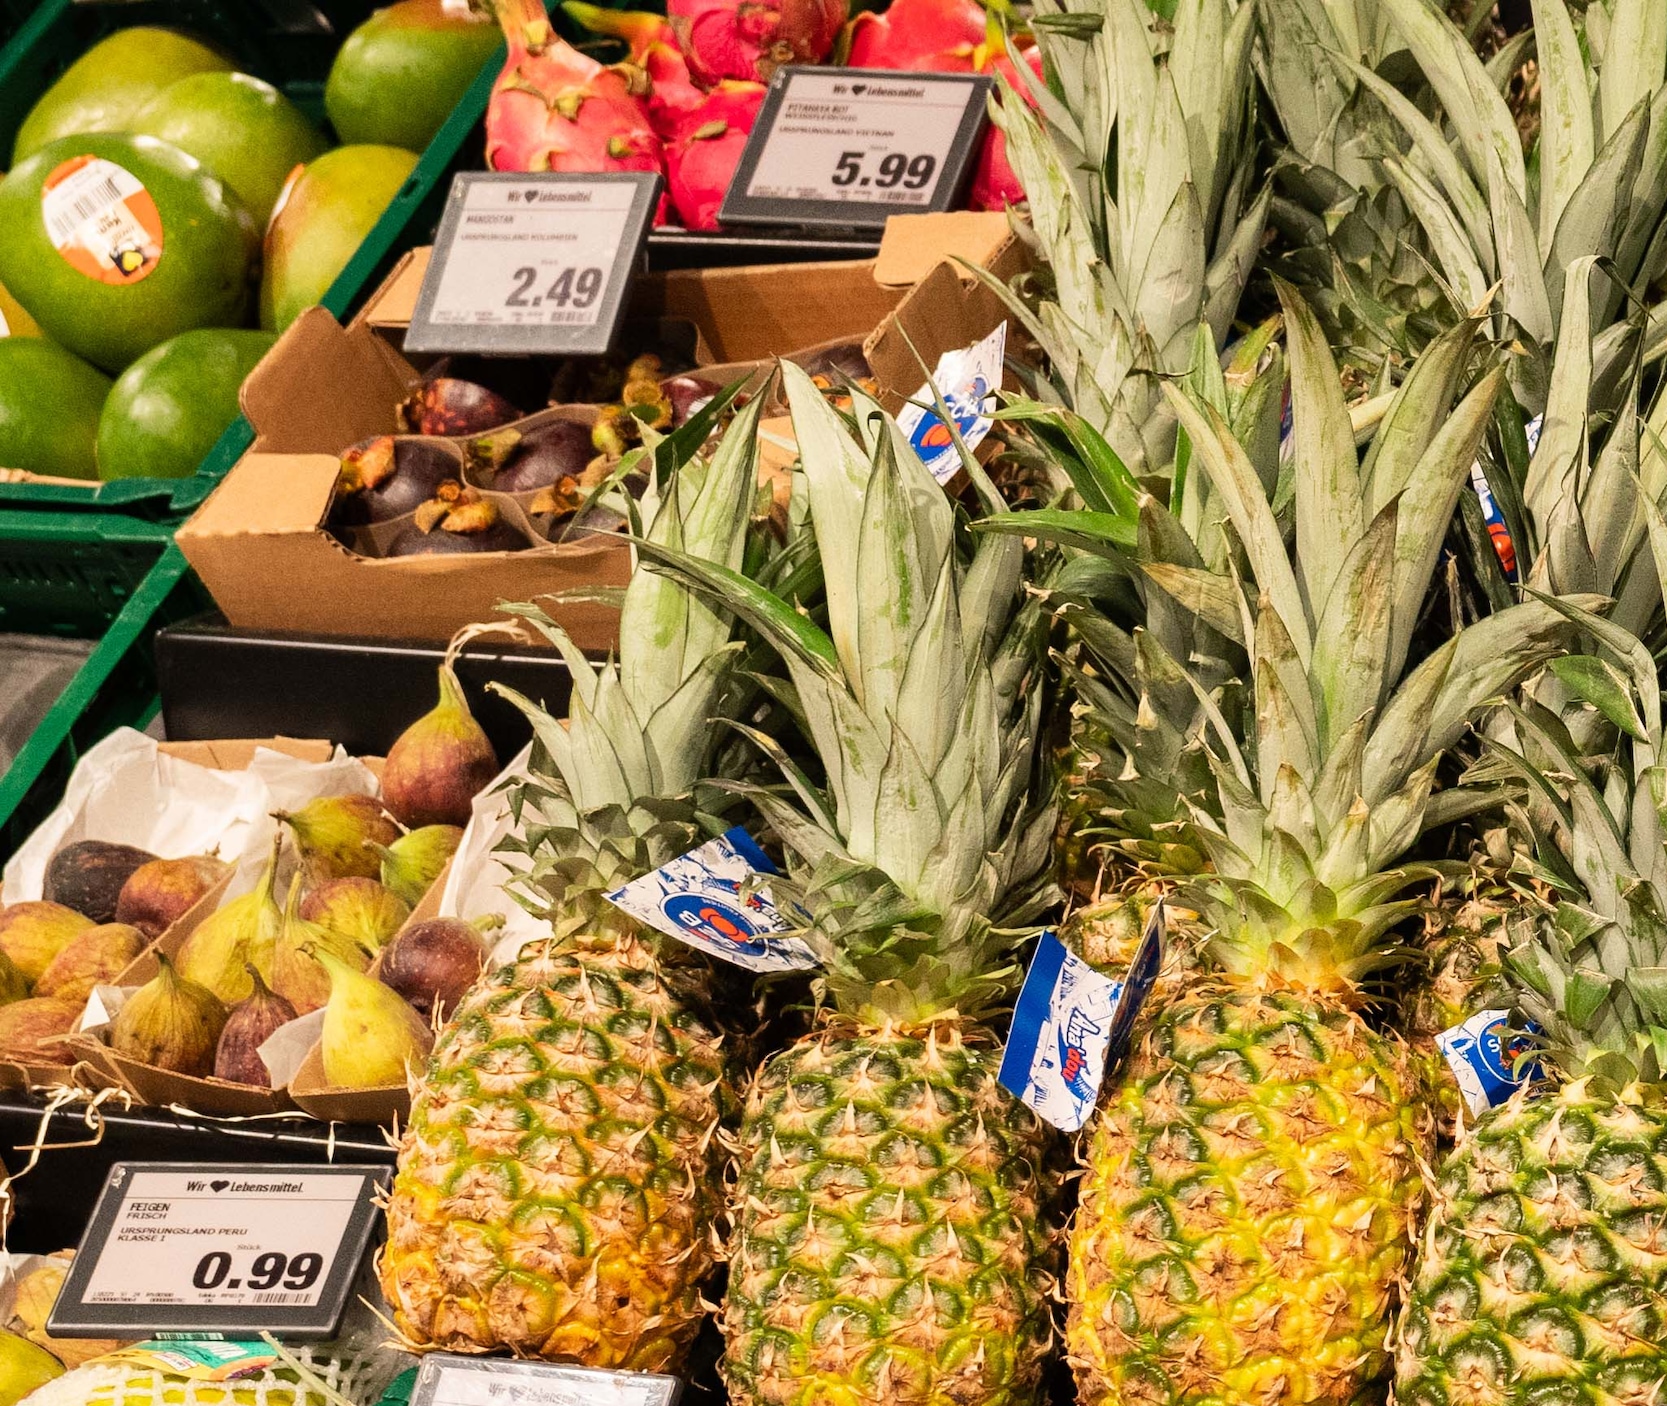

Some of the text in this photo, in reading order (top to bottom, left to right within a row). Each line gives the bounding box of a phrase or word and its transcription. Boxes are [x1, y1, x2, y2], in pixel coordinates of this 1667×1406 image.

[831, 151, 936, 189] 5.99
[504, 266, 603, 308] 2.49
[187, 1181, 207, 1192] Wir
[130, 1203, 170, 1212] FEIGEN
[126, 1212, 167, 1220] FRISCH
[120, 1227, 248, 1236] URSPRUNGSLAND PERU
[192, 1251, 323, 1291] 0.99
